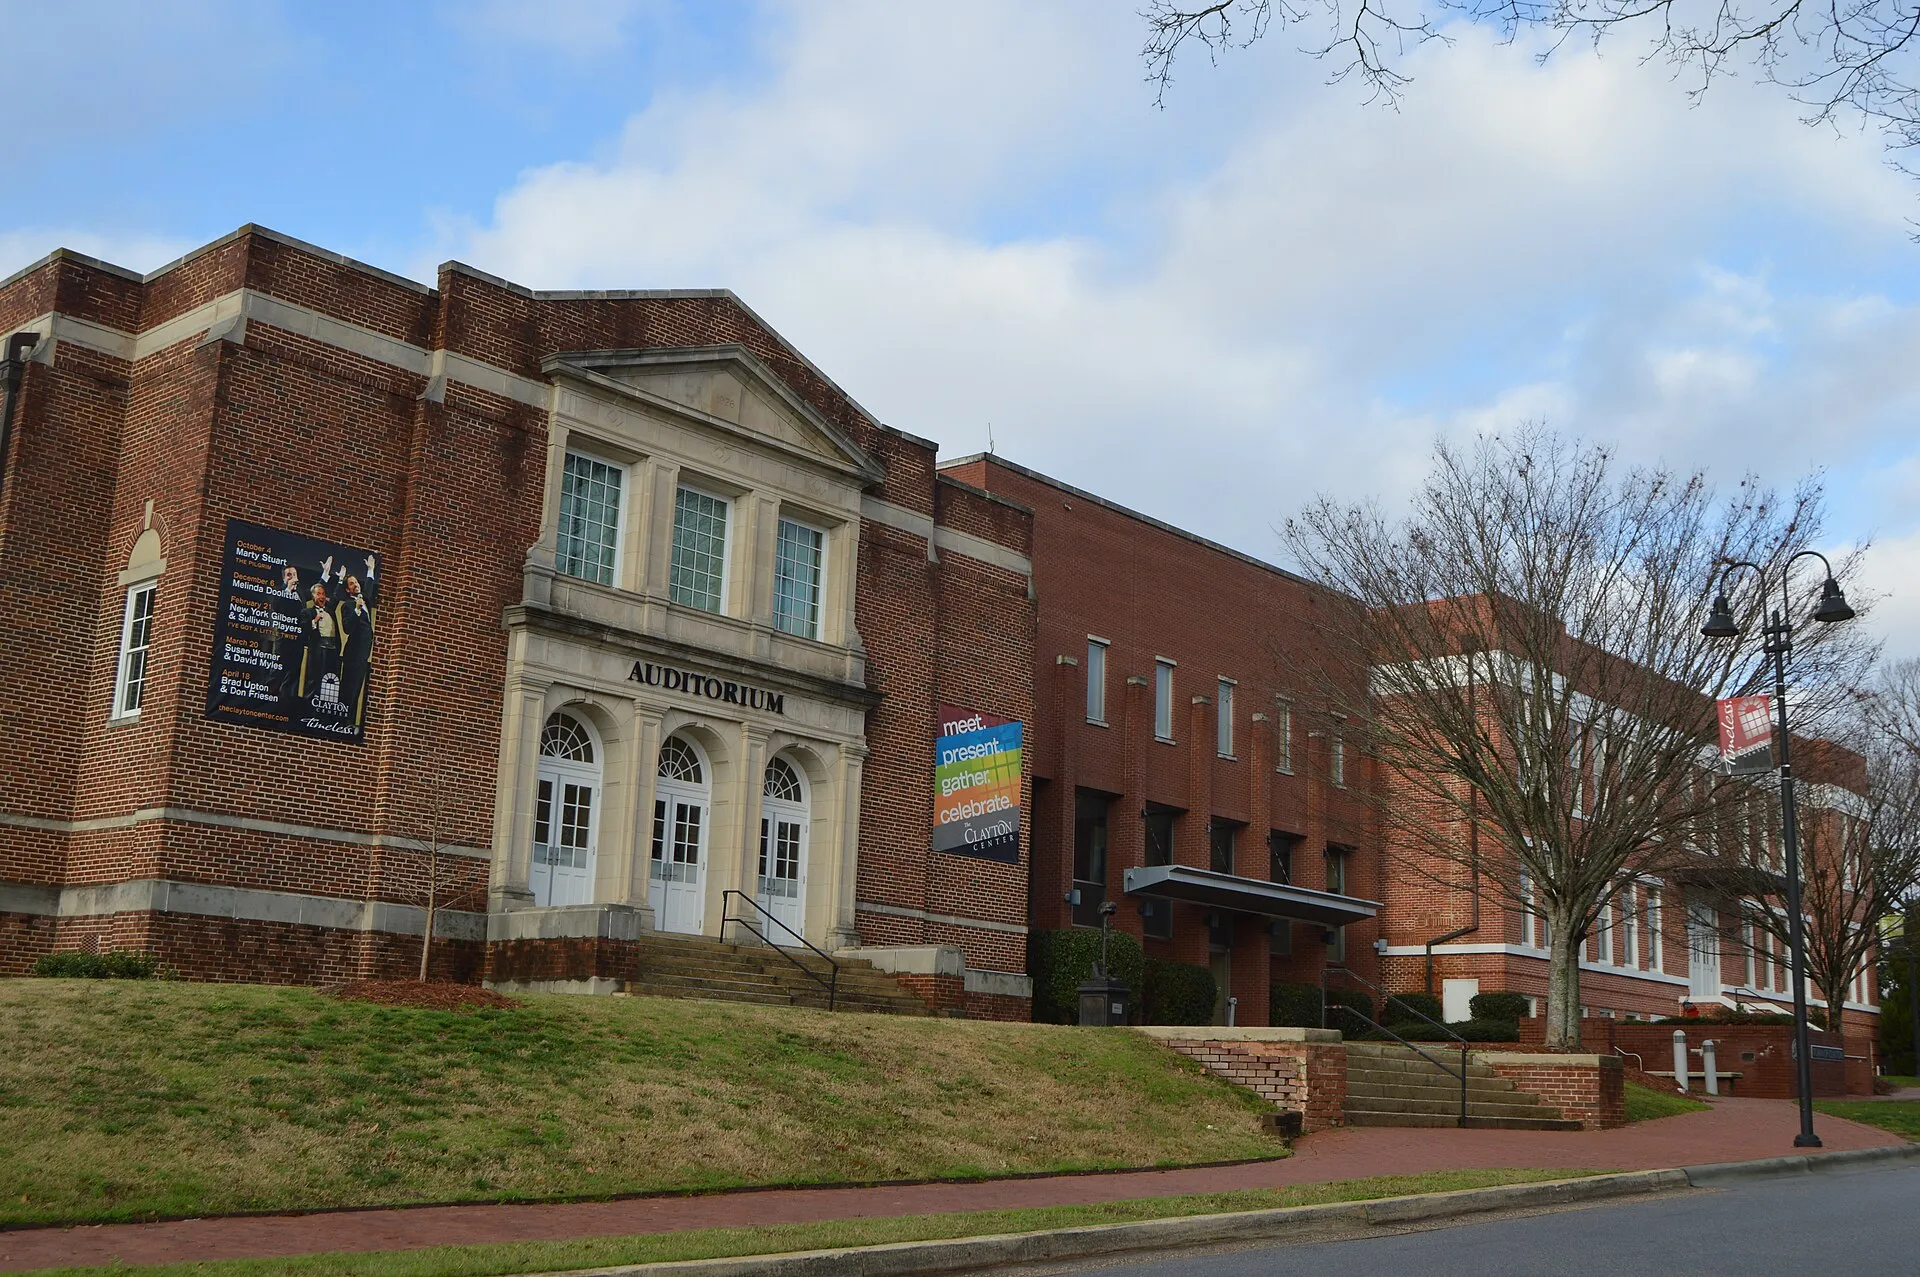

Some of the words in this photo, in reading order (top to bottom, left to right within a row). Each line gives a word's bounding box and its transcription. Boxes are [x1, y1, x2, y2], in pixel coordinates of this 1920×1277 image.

[237, 540, 265, 551] October
[236, 548, 260, 560] Marty
[262, 554, 287, 565] Stuart
[234, 572, 268, 585] December
[233, 580, 263, 592] Melinda
[266, 587, 299, 600] Doolittle
[231, 596, 261, 607] February
[230, 603, 248, 613] New
[251, 608, 268, 618] York
[271, 612, 298, 624] Gilbert
[229, 612, 235, 620] &
[239, 614, 269, 626] Sullivan
[273, 621, 302, 634] Players
[225, 637, 247, 646] March
[225, 644, 250, 655] Susan
[253, 649, 280, 660] Werner
[234, 654, 257, 665] David
[260, 660, 283, 670] Myles
[222, 669, 239, 678] April
[221, 677, 241, 686] Brad
[244, 681, 269, 692] Upton
[628, 661, 784, 714] AUDITORIUM
[220, 685, 227, 693] &
[230, 687, 246, 696] Don
[249, 690, 278, 702] Friesen
[219, 705, 289, 722] theclaytoncenter.com
[312, 698, 349, 712] CLAYTON
[943, 714, 986, 736] meet.
[943, 737, 1003, 768] present.
[942, 769, 991, 797] gather.
[940, 794, 1013, 824] celebrate.
[964, 820, 1013, 844] CLAYTON
[973, 835, 1015, 851] CENTER
